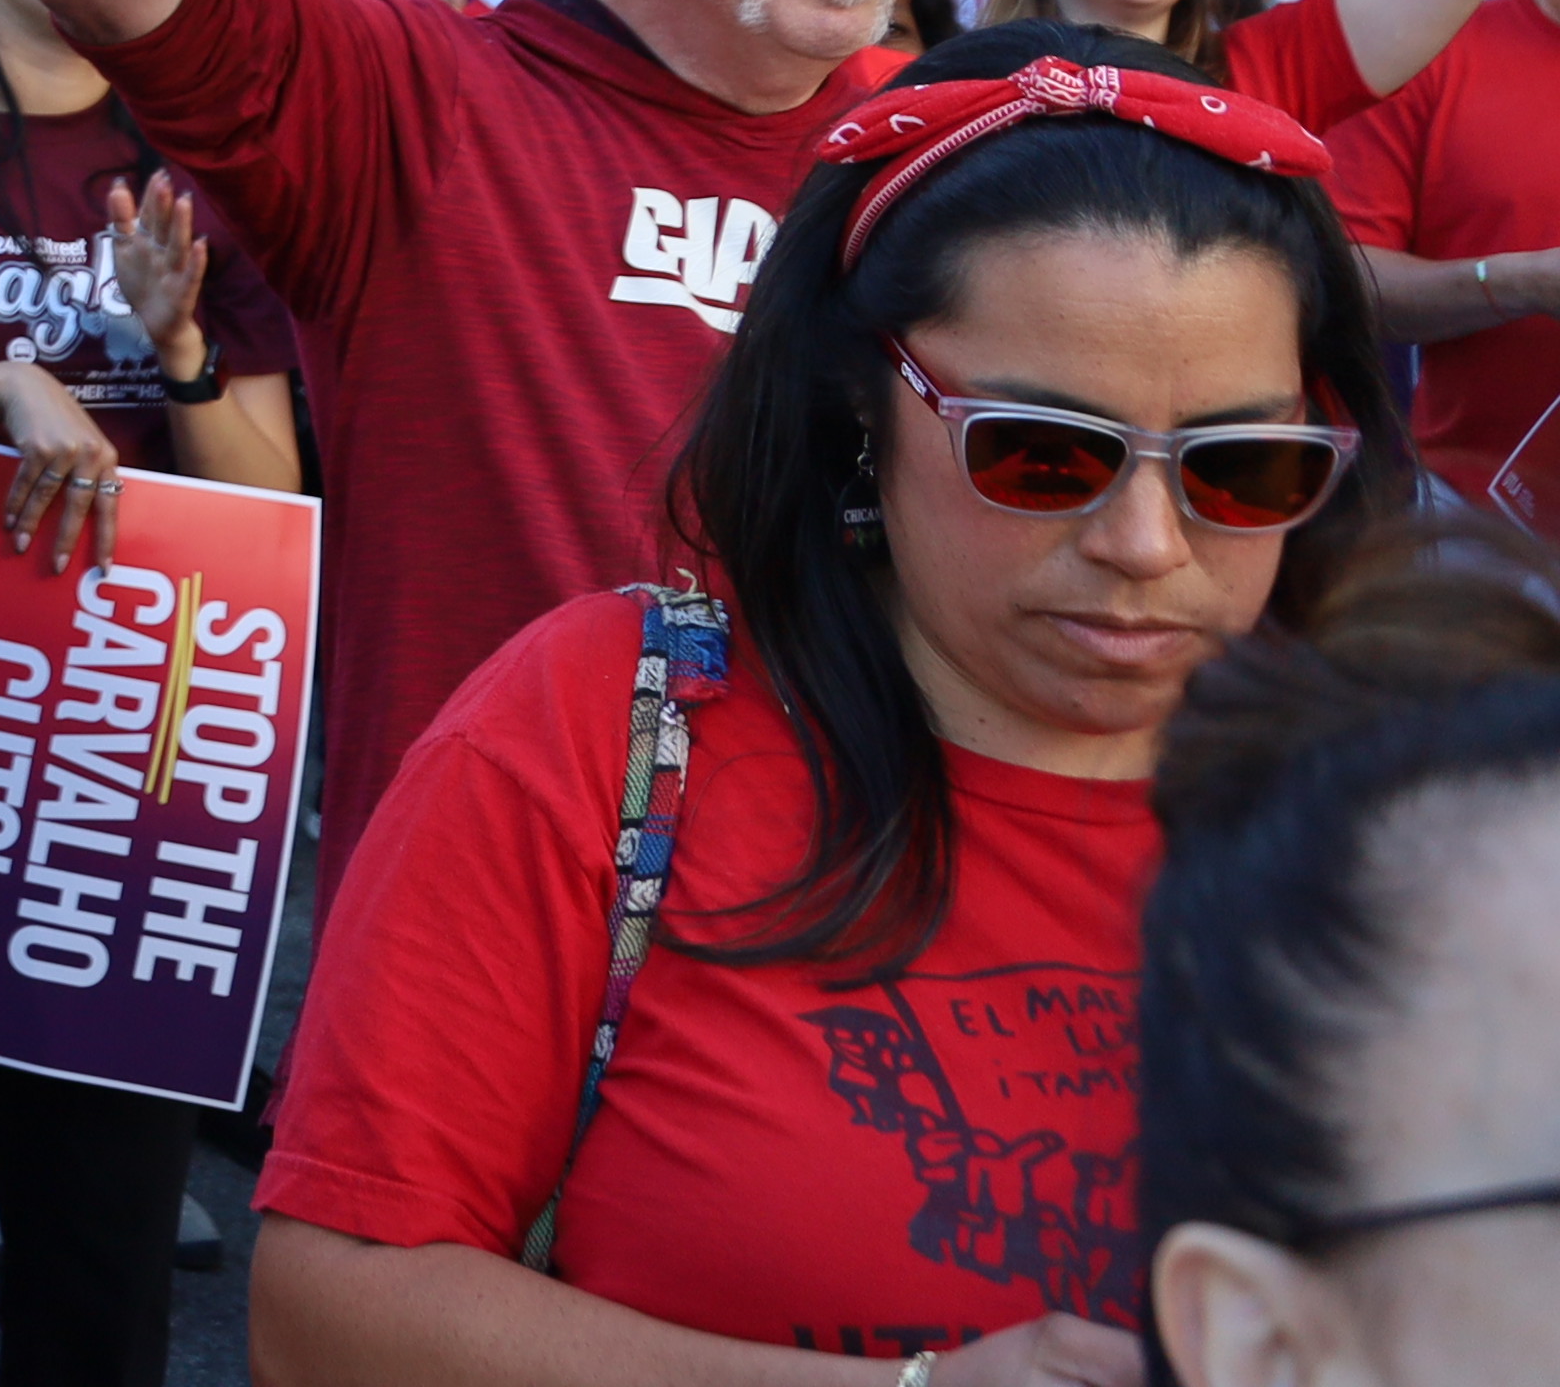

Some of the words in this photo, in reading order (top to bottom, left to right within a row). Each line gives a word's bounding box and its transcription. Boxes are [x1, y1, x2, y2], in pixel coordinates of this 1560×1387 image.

[6, 565, 176, 990] CARVALHO
[177, 598, 287, 824] STOP
[131, 837, 260, 997] THE
[949, 999, 1016, 1038] EL
